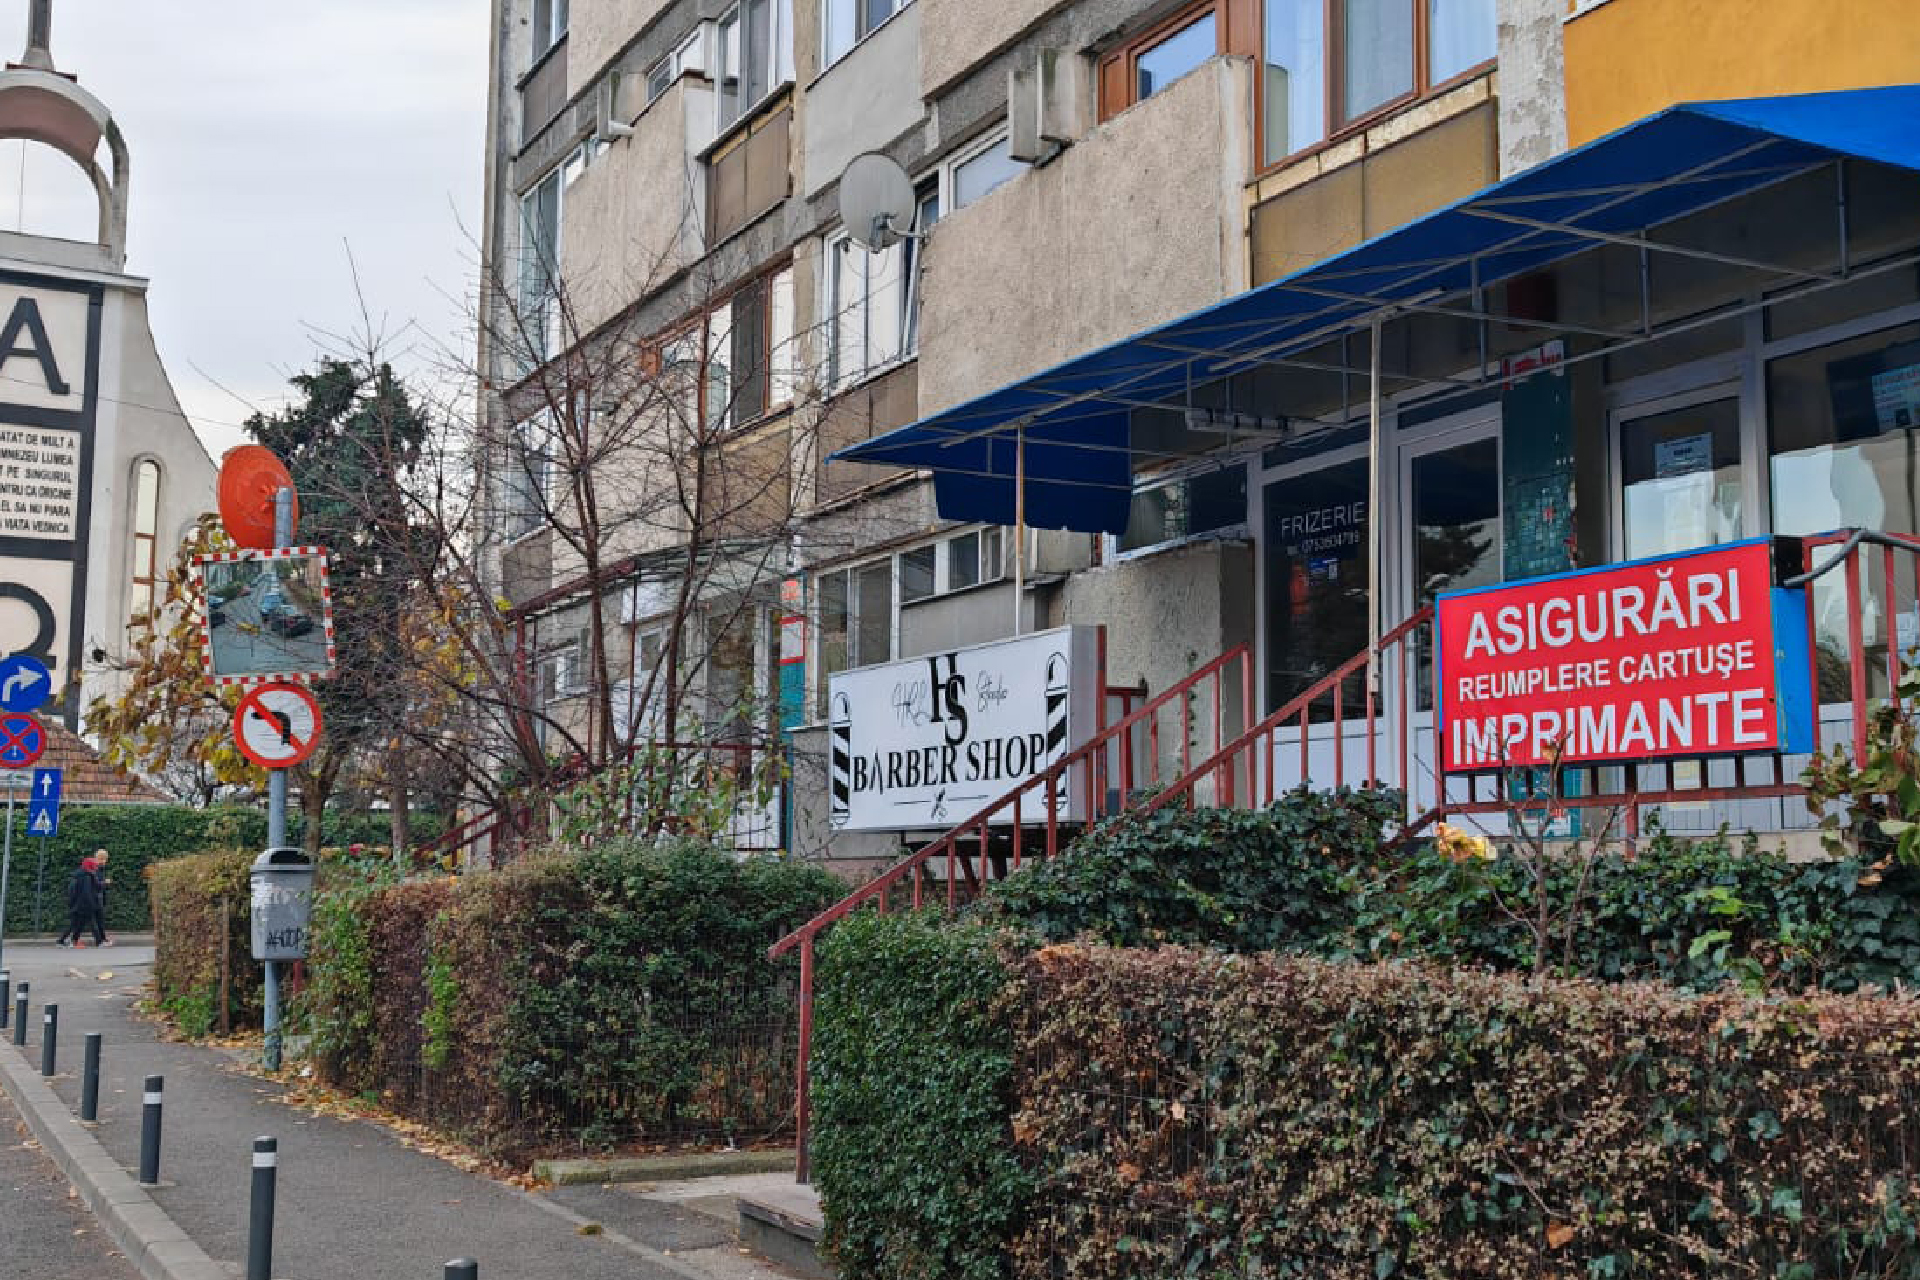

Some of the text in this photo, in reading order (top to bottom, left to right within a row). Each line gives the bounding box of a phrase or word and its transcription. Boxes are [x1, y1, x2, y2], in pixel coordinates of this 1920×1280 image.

[1281, 501, 1365, 540] FRIZERIE
[1464, 566, 1742, 660] ASIGURĂRI
[1459, 658, 1610, 701] REUMPLERE
[1452, 687, 1768, 766] IMPRIMANTE
[853, 733, 1045, 795] BARBER SHOP
